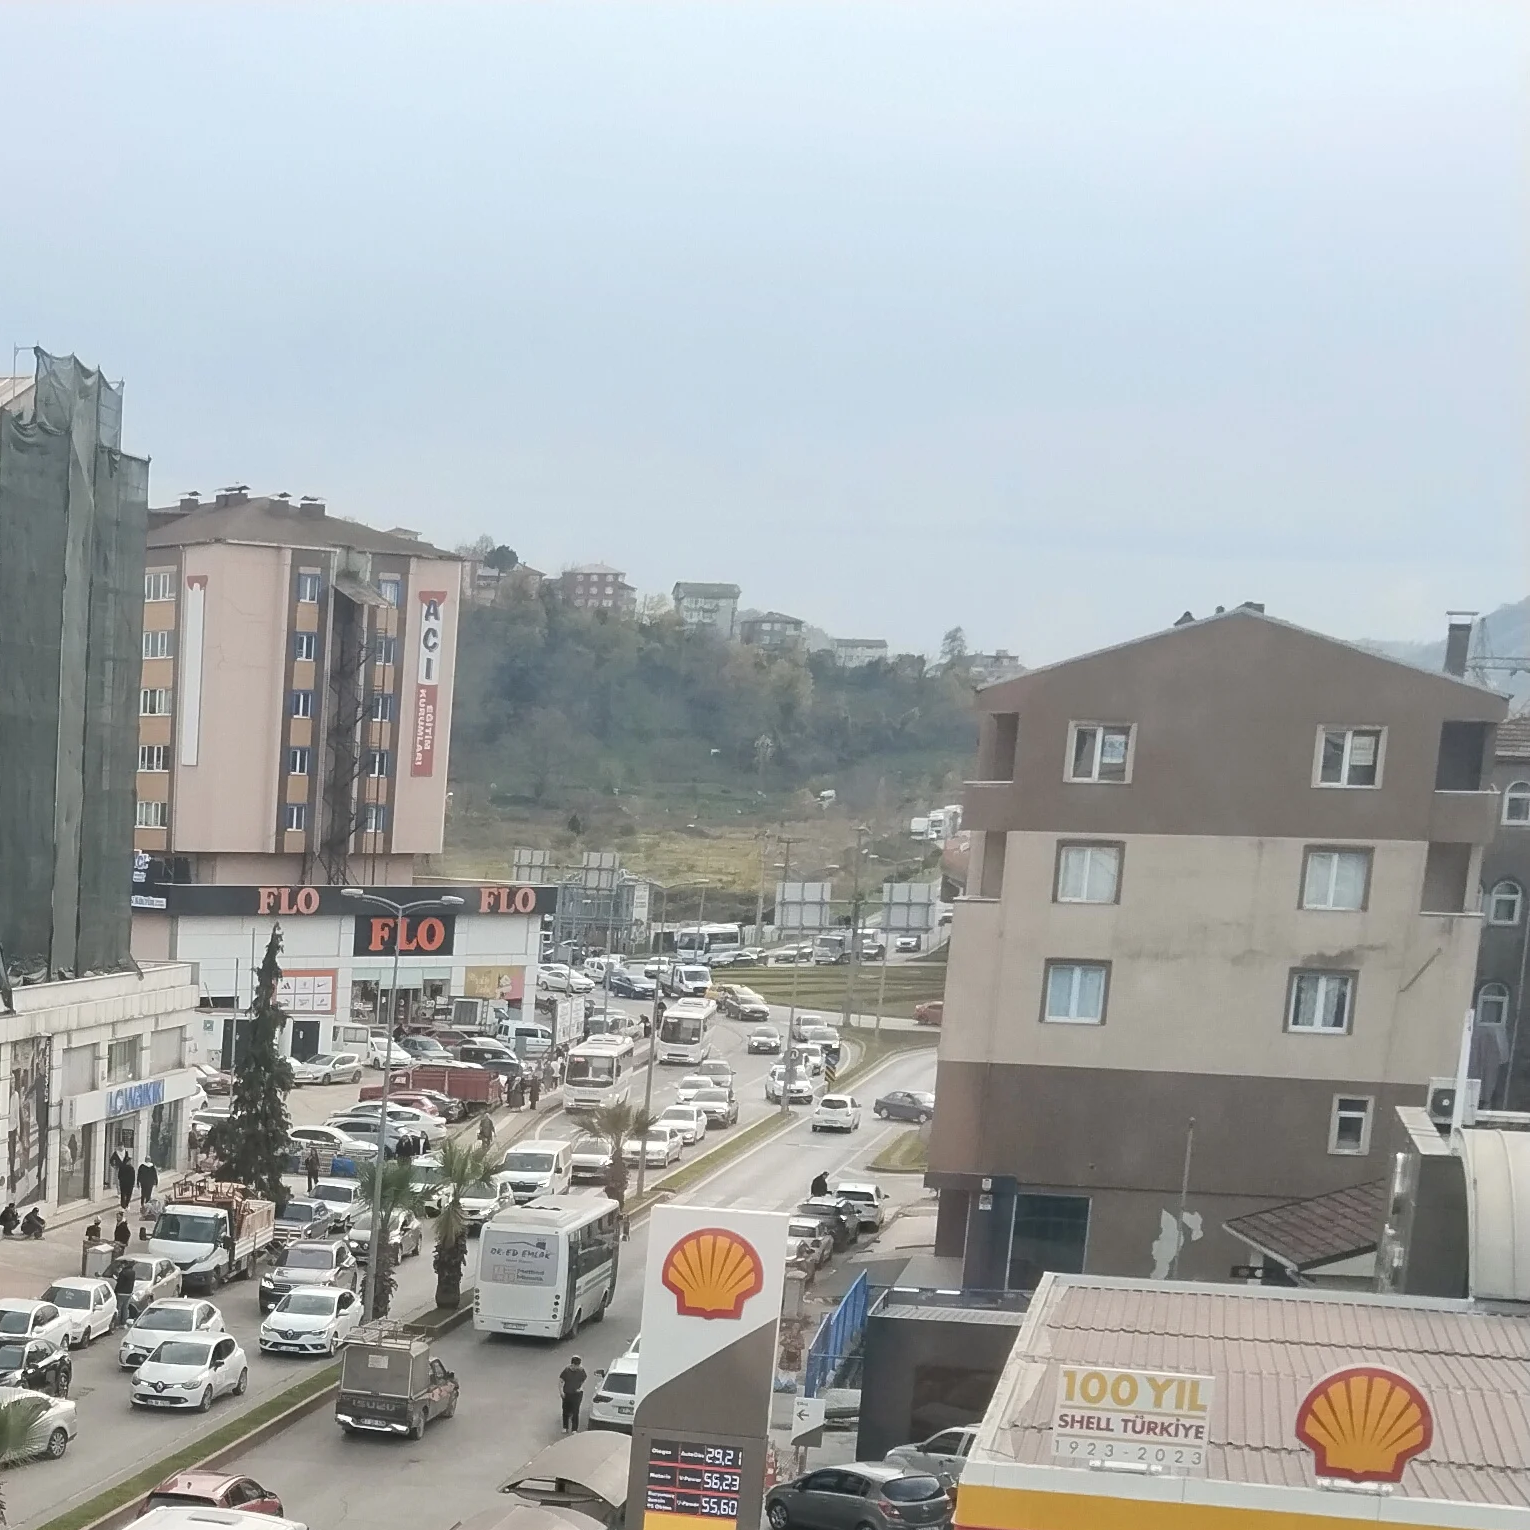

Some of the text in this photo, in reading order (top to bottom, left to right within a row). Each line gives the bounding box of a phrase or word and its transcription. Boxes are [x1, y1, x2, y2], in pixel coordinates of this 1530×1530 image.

[423, 599, 440, 680] AÇI
[258, 887, 320, 915] FLO
[479, 887, 537, 914] FLO
[369, 917, 445, 951] FLO
[1063, 1370, 1208, 1412] 100 YIL
[353, 1399, 396, 1411] ISUZU
[1058, 1413, 1206, 1440] SHELL TÜRKİYE
[706, 1447, 742, 1466] 29,21
[703, 1472, 740, 1491] 56,23
[701, 1498, 737, 1515] 55,60
